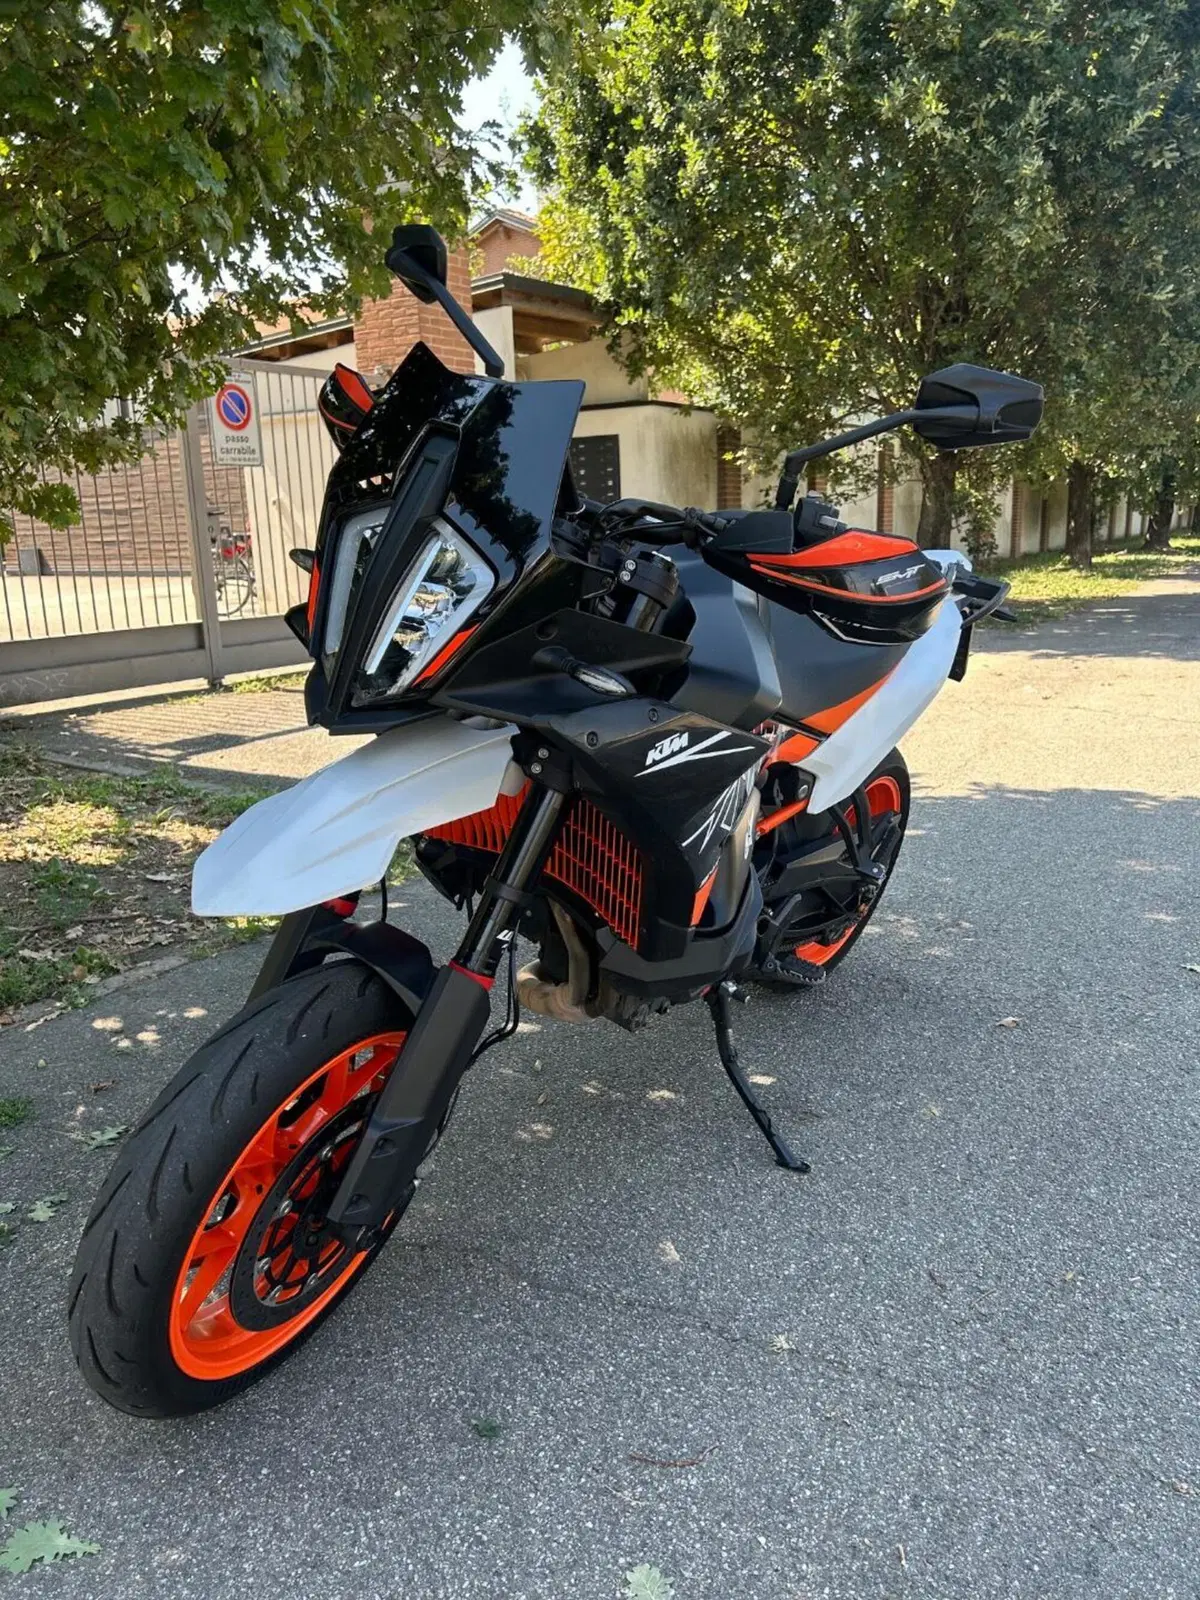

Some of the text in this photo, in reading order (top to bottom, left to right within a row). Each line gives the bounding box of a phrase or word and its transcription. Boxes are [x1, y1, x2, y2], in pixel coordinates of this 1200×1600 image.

[225, 435, 249, 444] passo
[220, 446, 256, 455] carrabile
[645, 732, 689, 766] KTM
